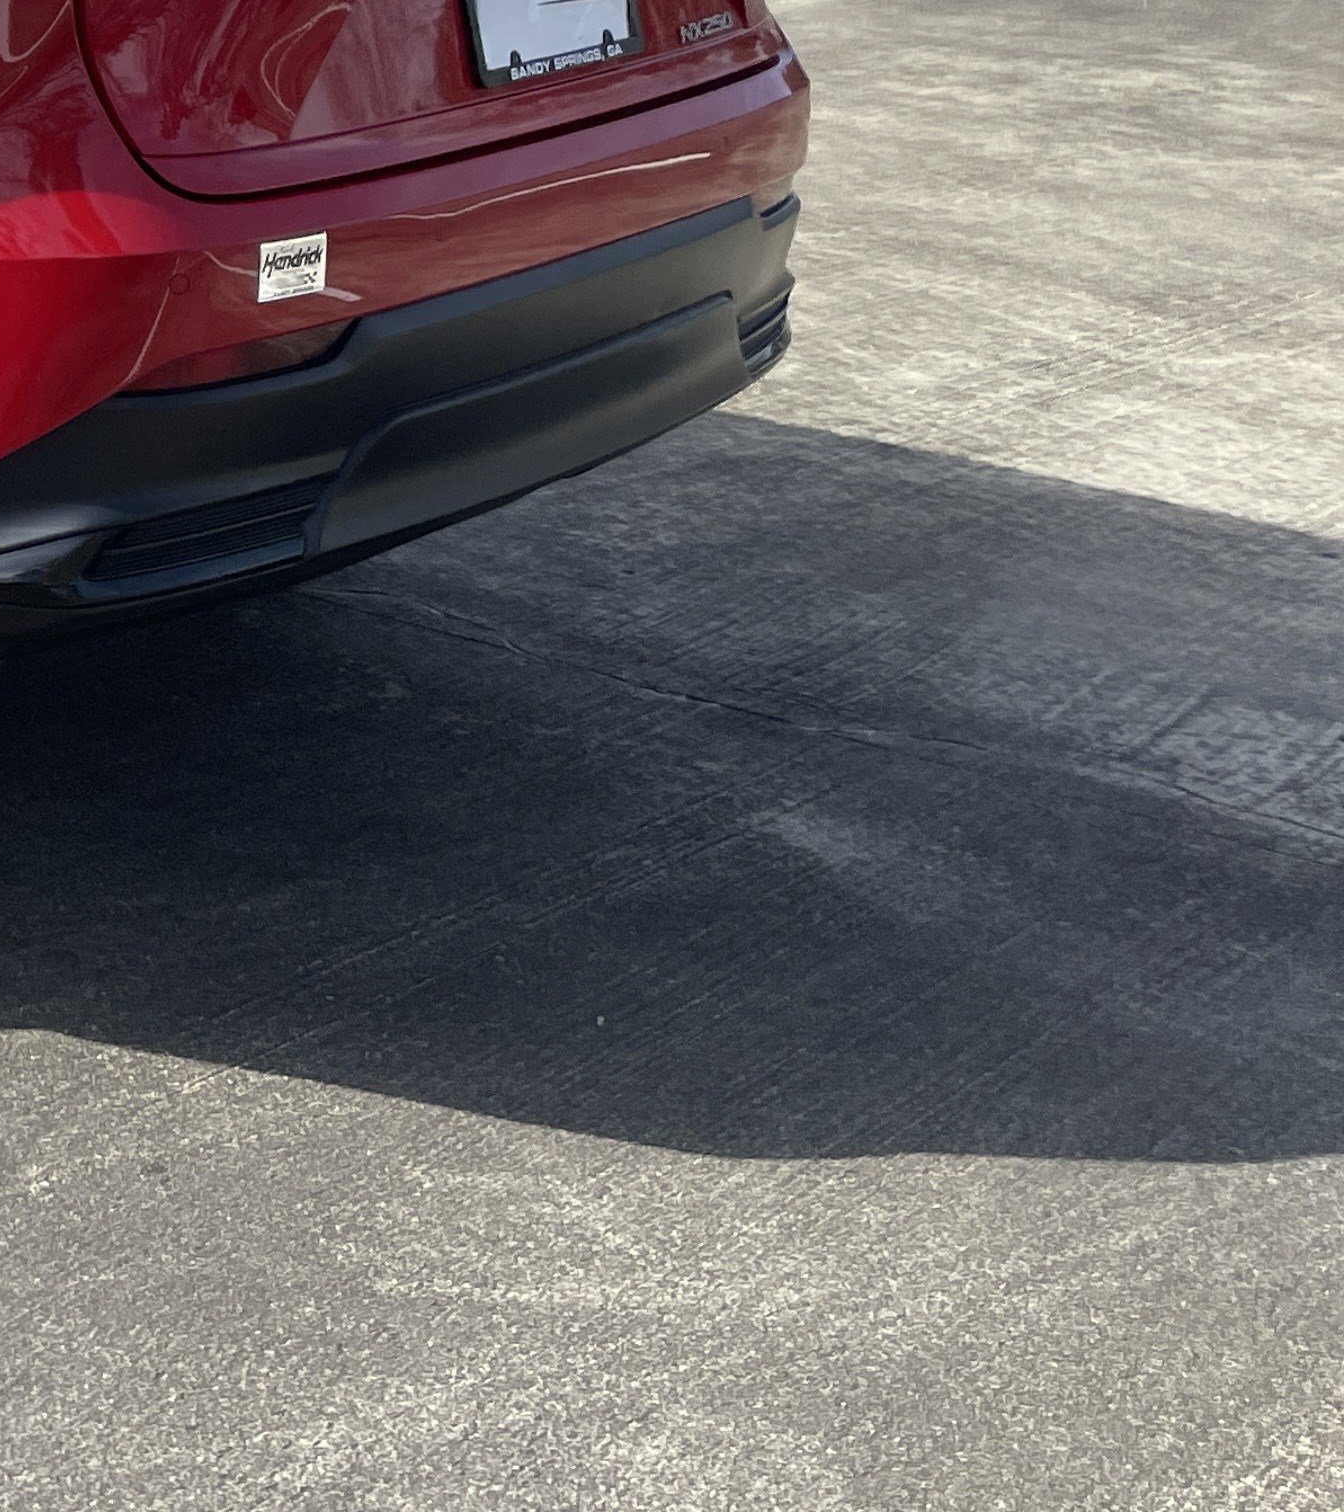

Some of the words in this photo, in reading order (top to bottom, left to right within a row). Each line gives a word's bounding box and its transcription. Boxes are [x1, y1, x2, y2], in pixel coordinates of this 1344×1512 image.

[510, 59, 552, 81] SANDY
[606, 43, 623, 58] GA
[261, 244, 323, 279] Hendrick
